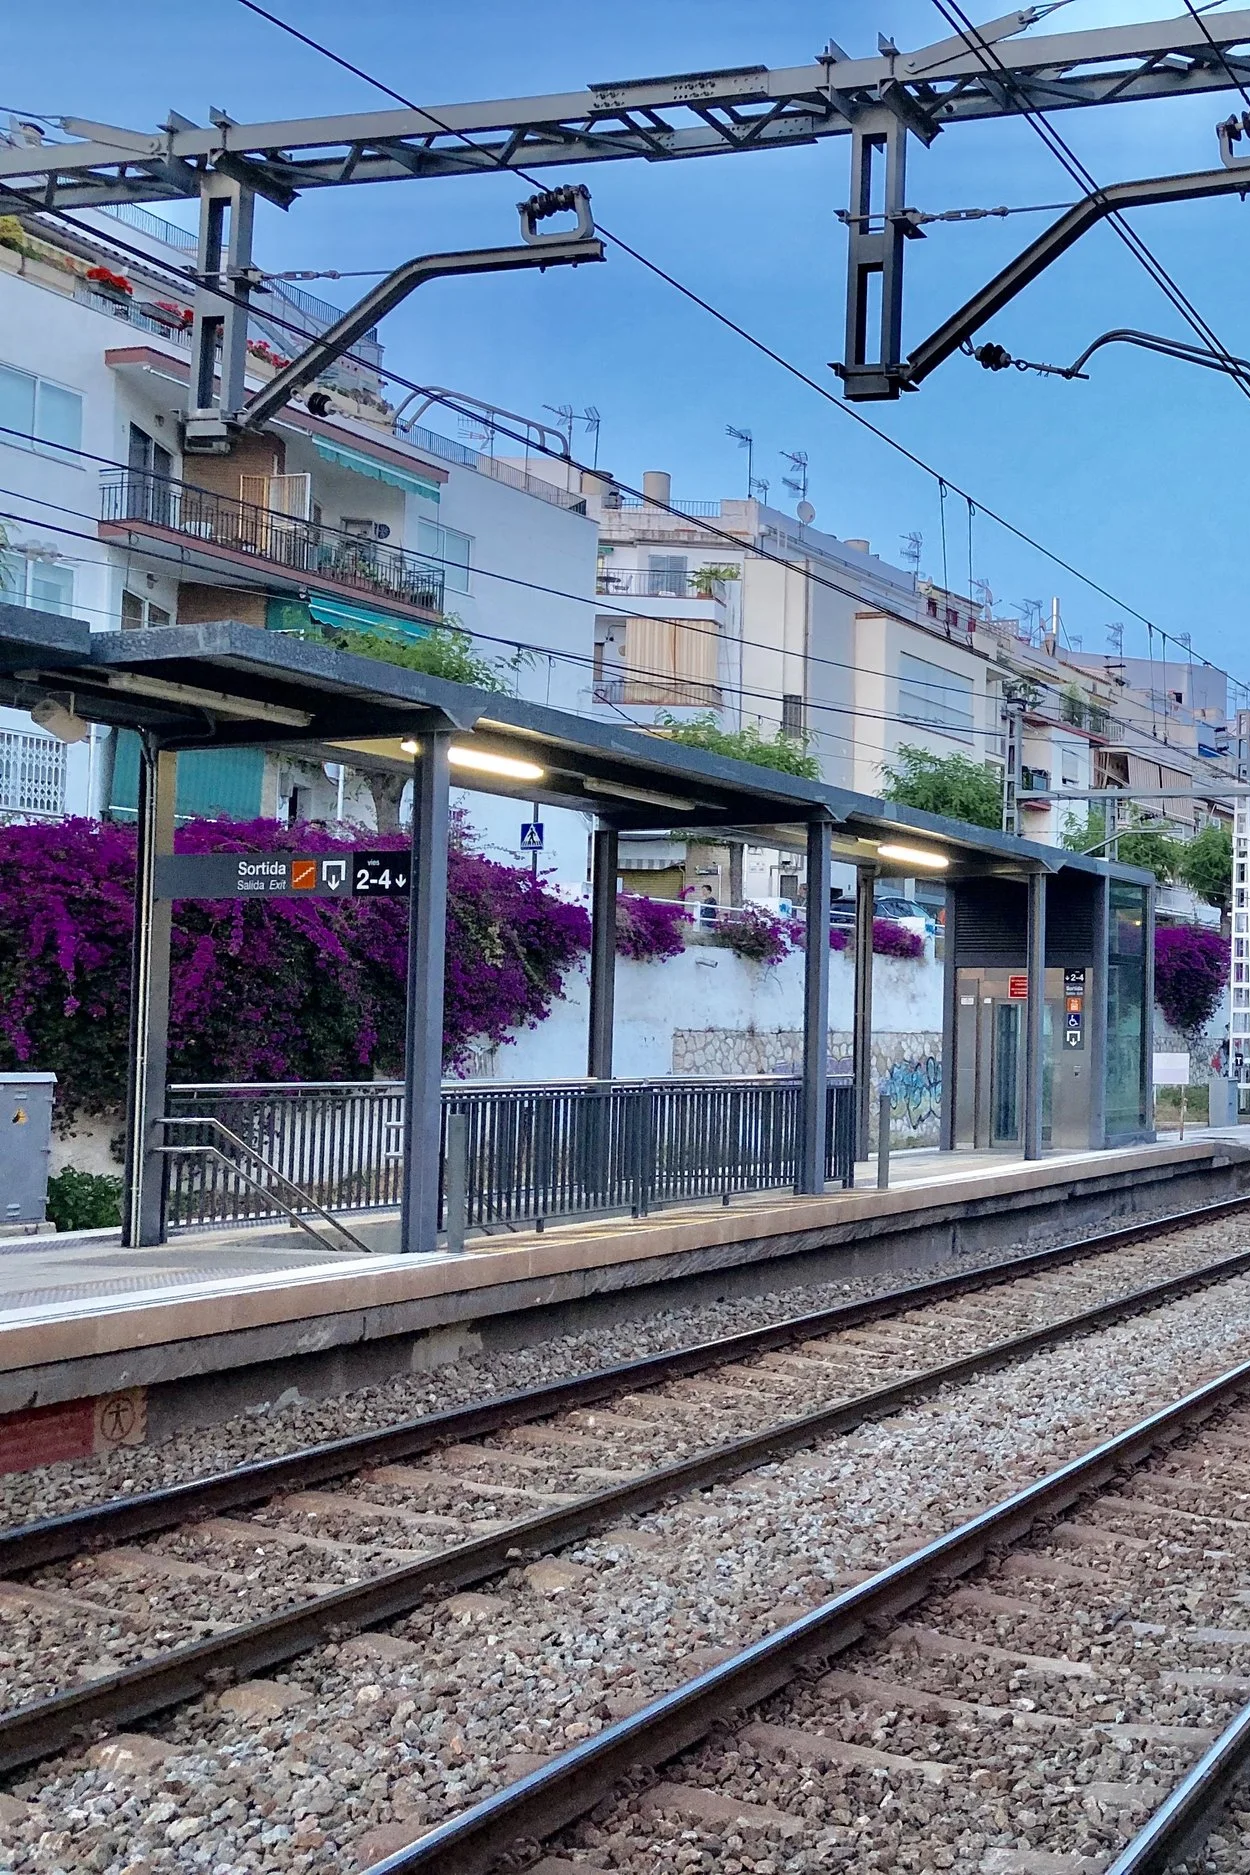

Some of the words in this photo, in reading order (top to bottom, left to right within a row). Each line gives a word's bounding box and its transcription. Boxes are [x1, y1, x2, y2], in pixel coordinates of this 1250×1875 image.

[238, 861, 286, 876] Sortida
[237, 880, 264, 891] Salida
[269, 879, 286, 890] Exit
[356, 869, 391, 890] 2-4
[1070, 973, 1084, 982] 2-4
